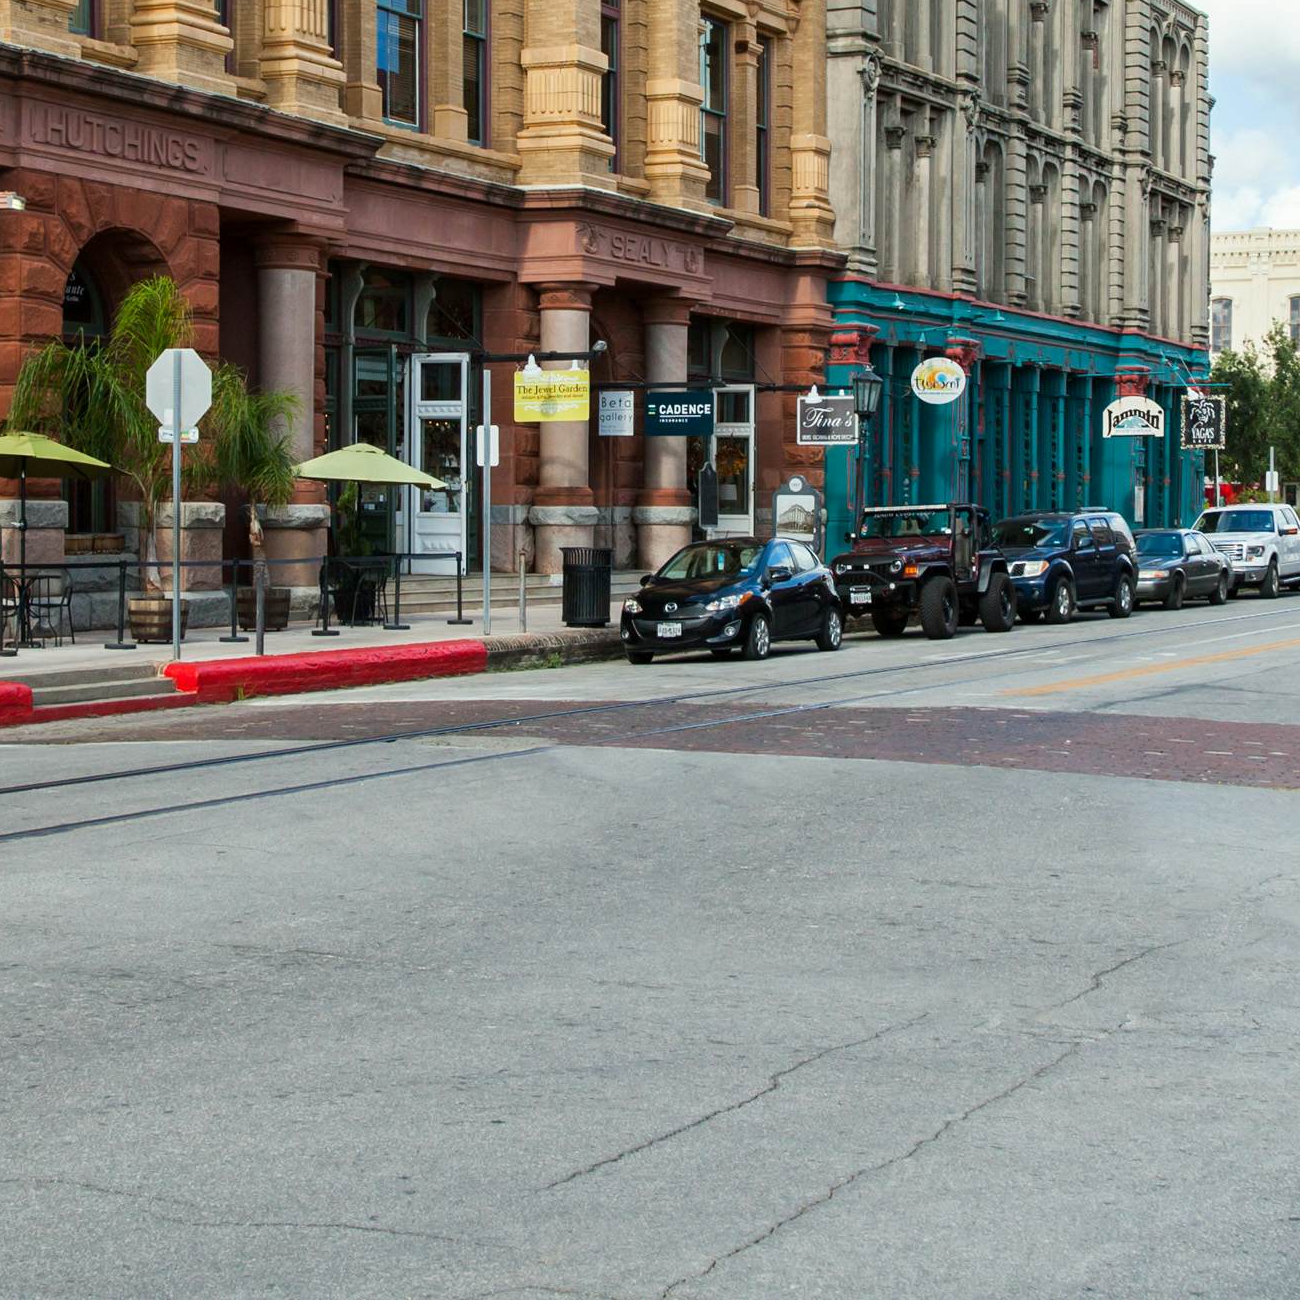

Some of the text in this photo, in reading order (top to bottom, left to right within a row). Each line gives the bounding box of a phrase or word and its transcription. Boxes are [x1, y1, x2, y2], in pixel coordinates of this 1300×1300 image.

[47, 107, 201, 171] HUTCHINGS
[611, 234, 674, 268] SEALY
[515, 384, 588, 395] The Jewel Garden
[601, 396, 632, 409] Beta
[659, 404, 711, 415] CADENCE
[600, 412, 633, 423] gallery
[802, 407, 853, 428] Tina's
[1106, 409, 1162, 436] Jammin'
[1191, 427, 1215, 439] YAGA'S
